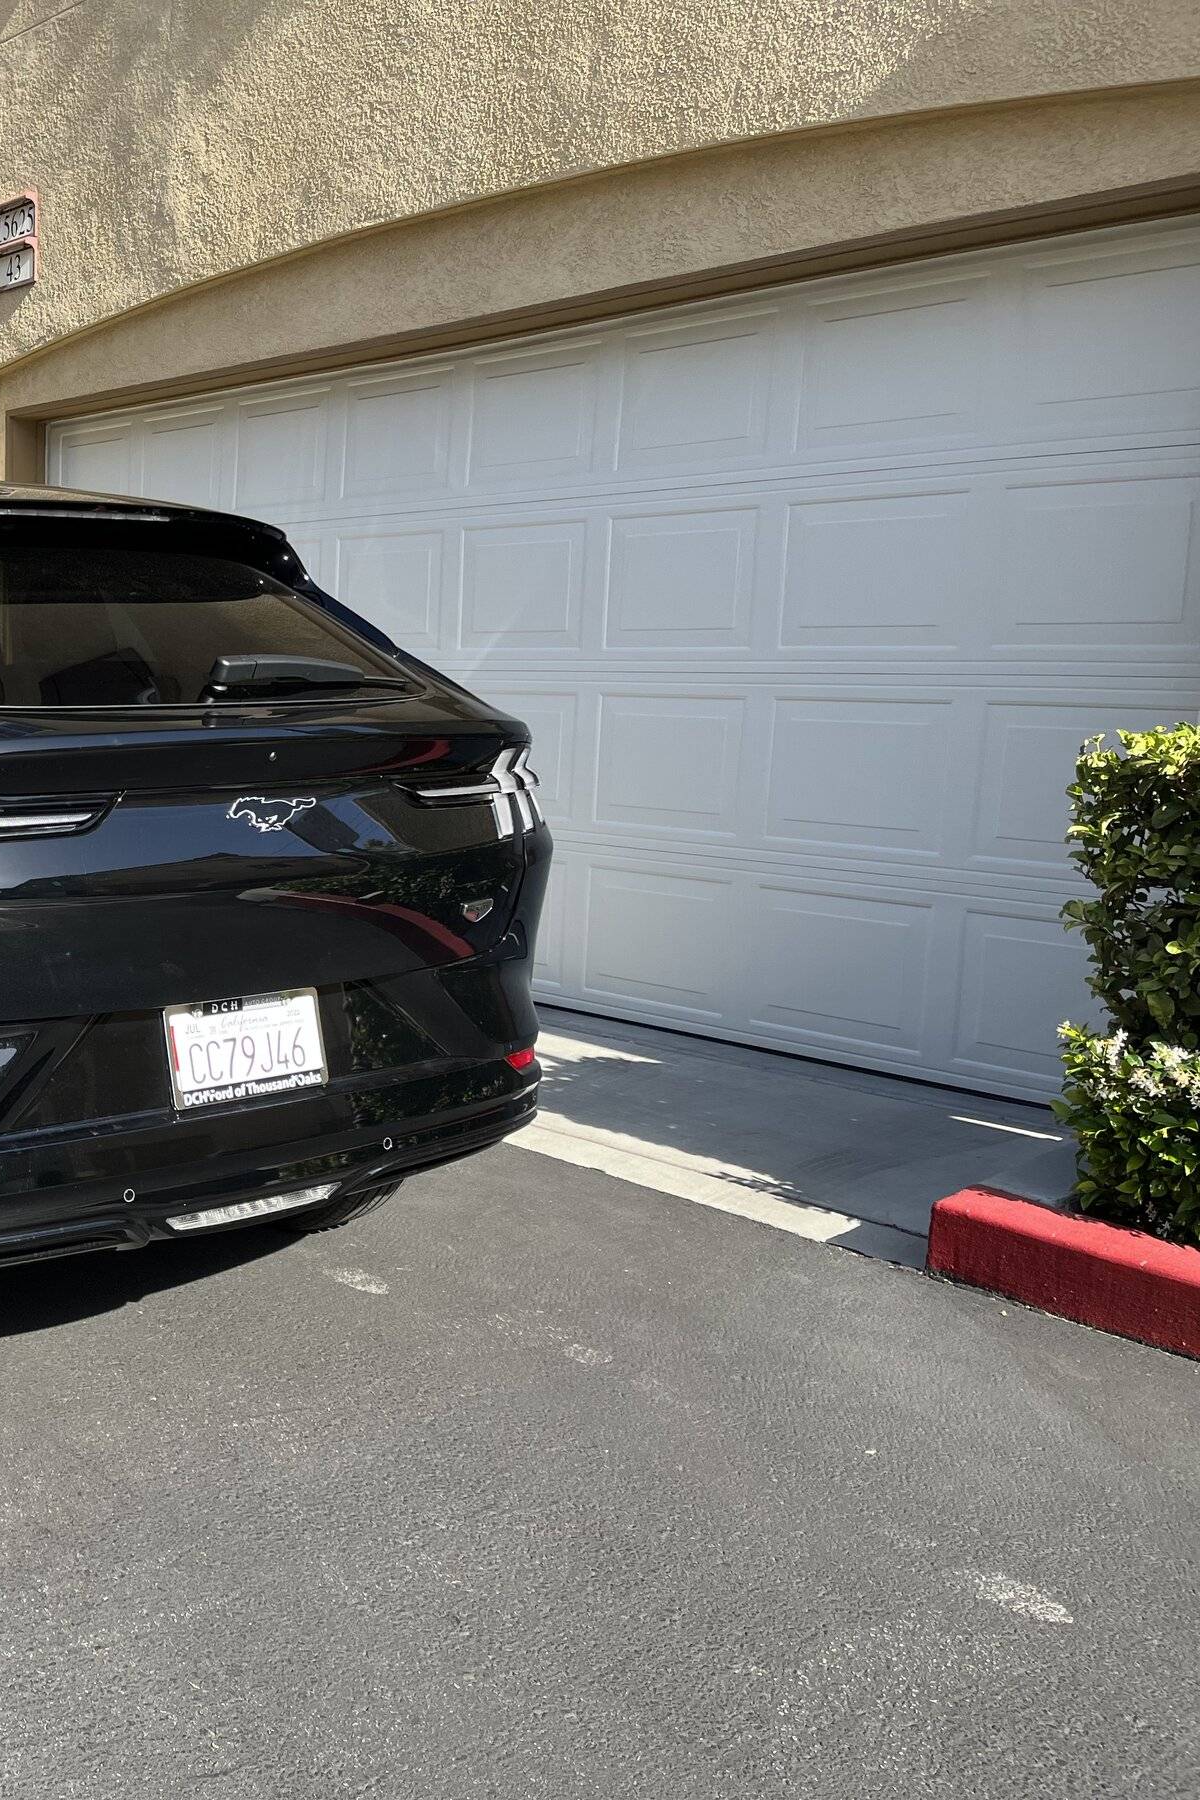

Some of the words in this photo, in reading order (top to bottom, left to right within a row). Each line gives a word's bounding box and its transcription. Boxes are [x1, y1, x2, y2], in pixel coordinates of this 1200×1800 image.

[6, 254, 21, 281] 43
[211, 1000, 238, 1014] DCH
[185, 1023, 201, 1035] JUL
[189, 1027, 306, 1084] CC79J46
[235, 1083, 246, 1097] of
[246, 1075, 296, 1095] Thousand
